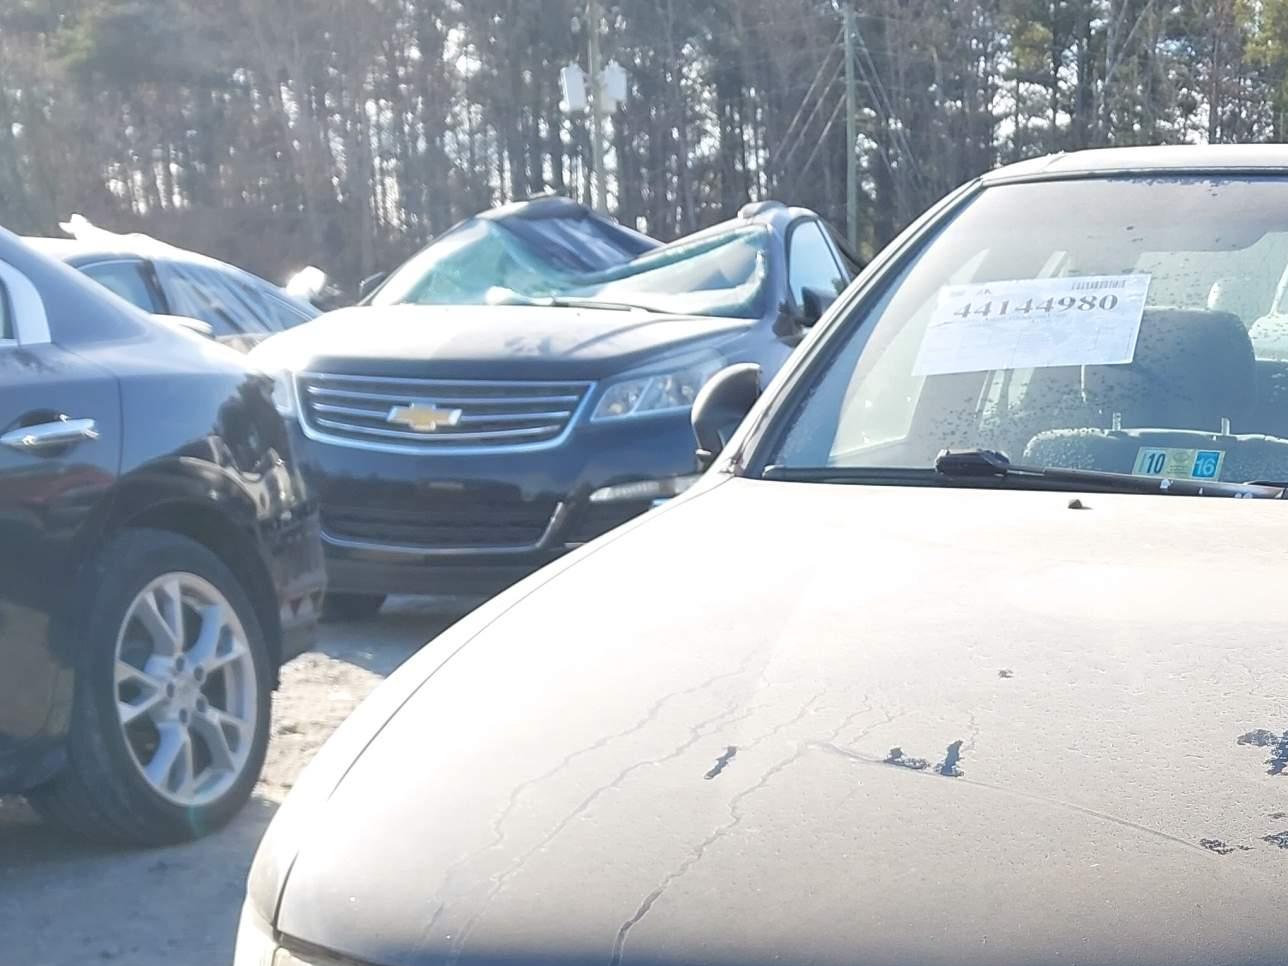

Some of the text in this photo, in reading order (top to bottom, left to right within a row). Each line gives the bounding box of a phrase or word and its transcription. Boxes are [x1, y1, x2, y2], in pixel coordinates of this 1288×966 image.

[953, 294, 1118, 318] 44144980
[1146, 453, 1167, 474] 10
[1196, 458, 1217, 475] 16
